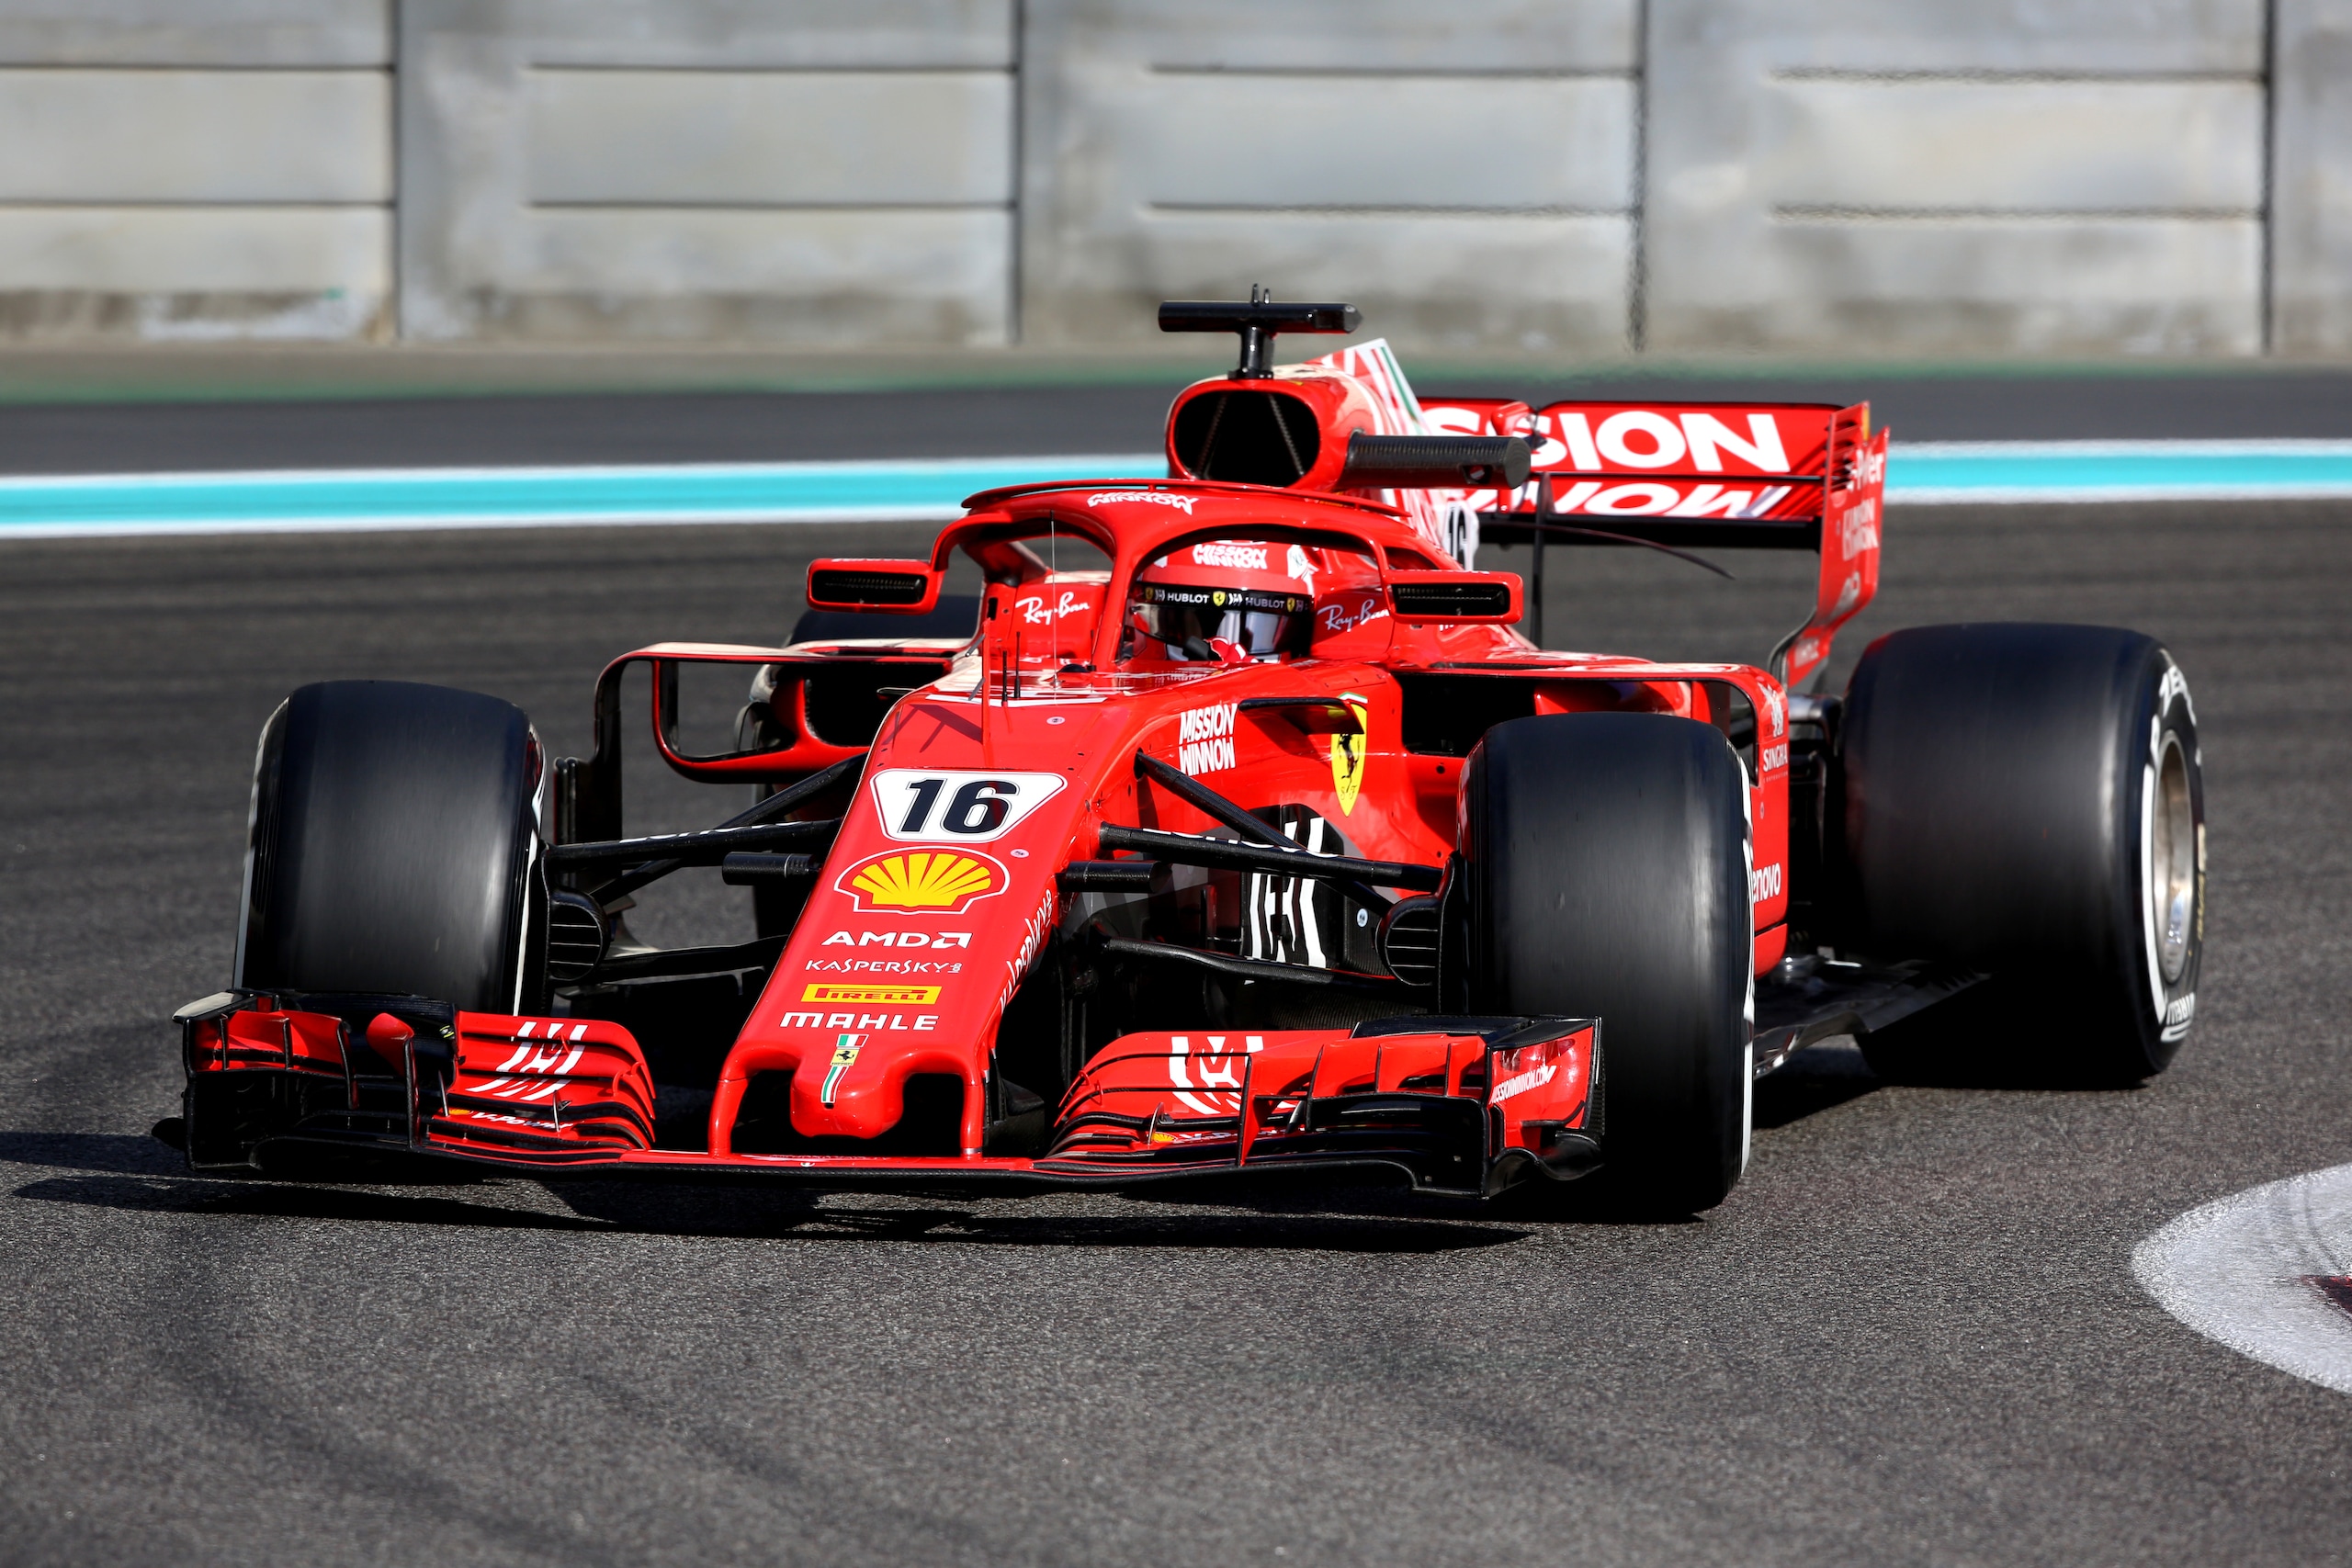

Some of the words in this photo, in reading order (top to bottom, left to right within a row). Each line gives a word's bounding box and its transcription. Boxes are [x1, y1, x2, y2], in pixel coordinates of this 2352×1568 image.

[1015, 591, 1090, 626] Ray-Ban
[1167, 592, 1210, 604] HUBLOT
[1245, 597, 1284, 608] HUBLOT
[1317, 599, 1389, 632] Ray-Ban
[1179, 703, 1238, 745] MISSION
[1179, 736, 1236, 777] WINNOW
[1763, 743, 1788, 772] SINGHA
[898, 777, 1020, 834] 16
[1753, 862, 1781, 905] enovo
[821, 931, 931, 948] AMD
[805, 958, 950, 975] KASPERSKY
[814, 987, 928, 1000] PIRELLI
[780, 1012, 940, 1031] MAHLE
